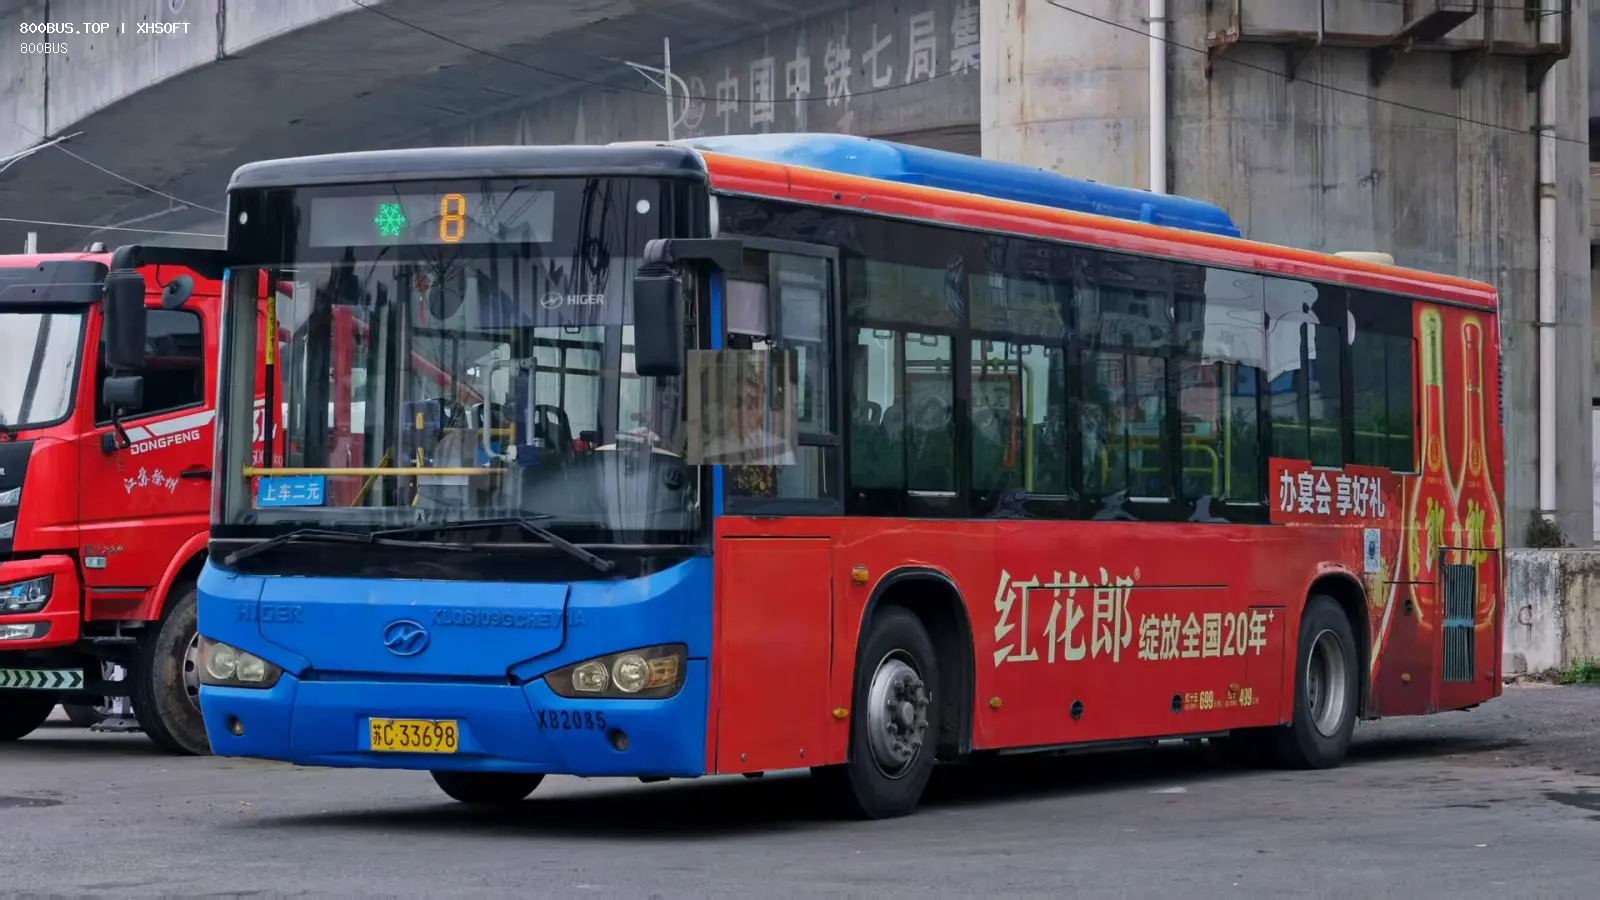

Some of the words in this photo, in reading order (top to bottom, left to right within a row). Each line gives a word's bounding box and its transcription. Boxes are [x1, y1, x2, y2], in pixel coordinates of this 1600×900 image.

[440, 194, 465, 242] 8
[567, 294, 604, 305] HIGER
[130, 430, 200, 455] DONGFENG
[262, 483, 320, 501] 上车二元
[1280, 469, 1331, 515] 办宴会
[1336, 474, 1385, 518] 享好礼
[235, 603, 304, 624] HIGER
[537, 709, 607, 730] XB2085
